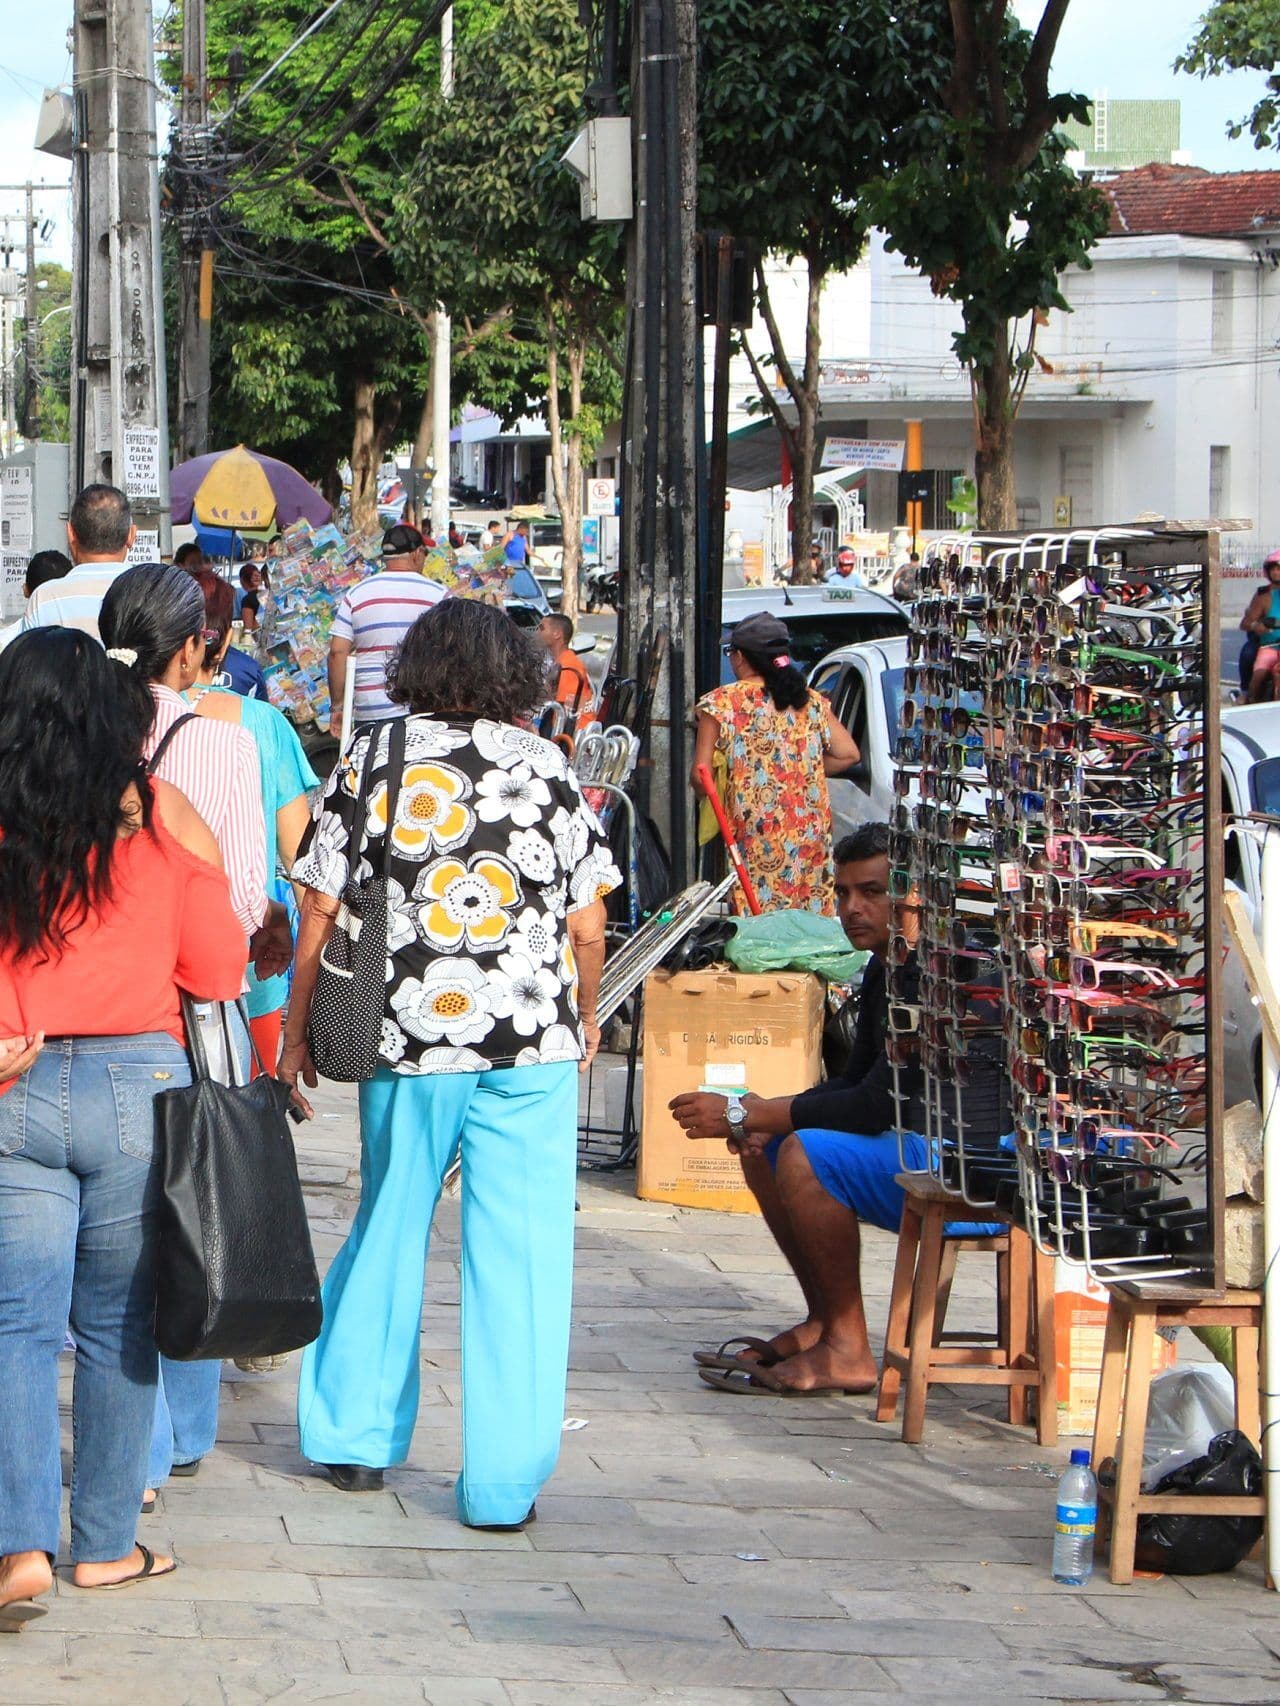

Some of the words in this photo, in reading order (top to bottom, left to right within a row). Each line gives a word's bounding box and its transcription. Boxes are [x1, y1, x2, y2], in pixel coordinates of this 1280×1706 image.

[133, 463, 151, 471] TEM
[128, 472, 155, 480] C.N.P.J
[827, 590, 852, 600] TAXI
